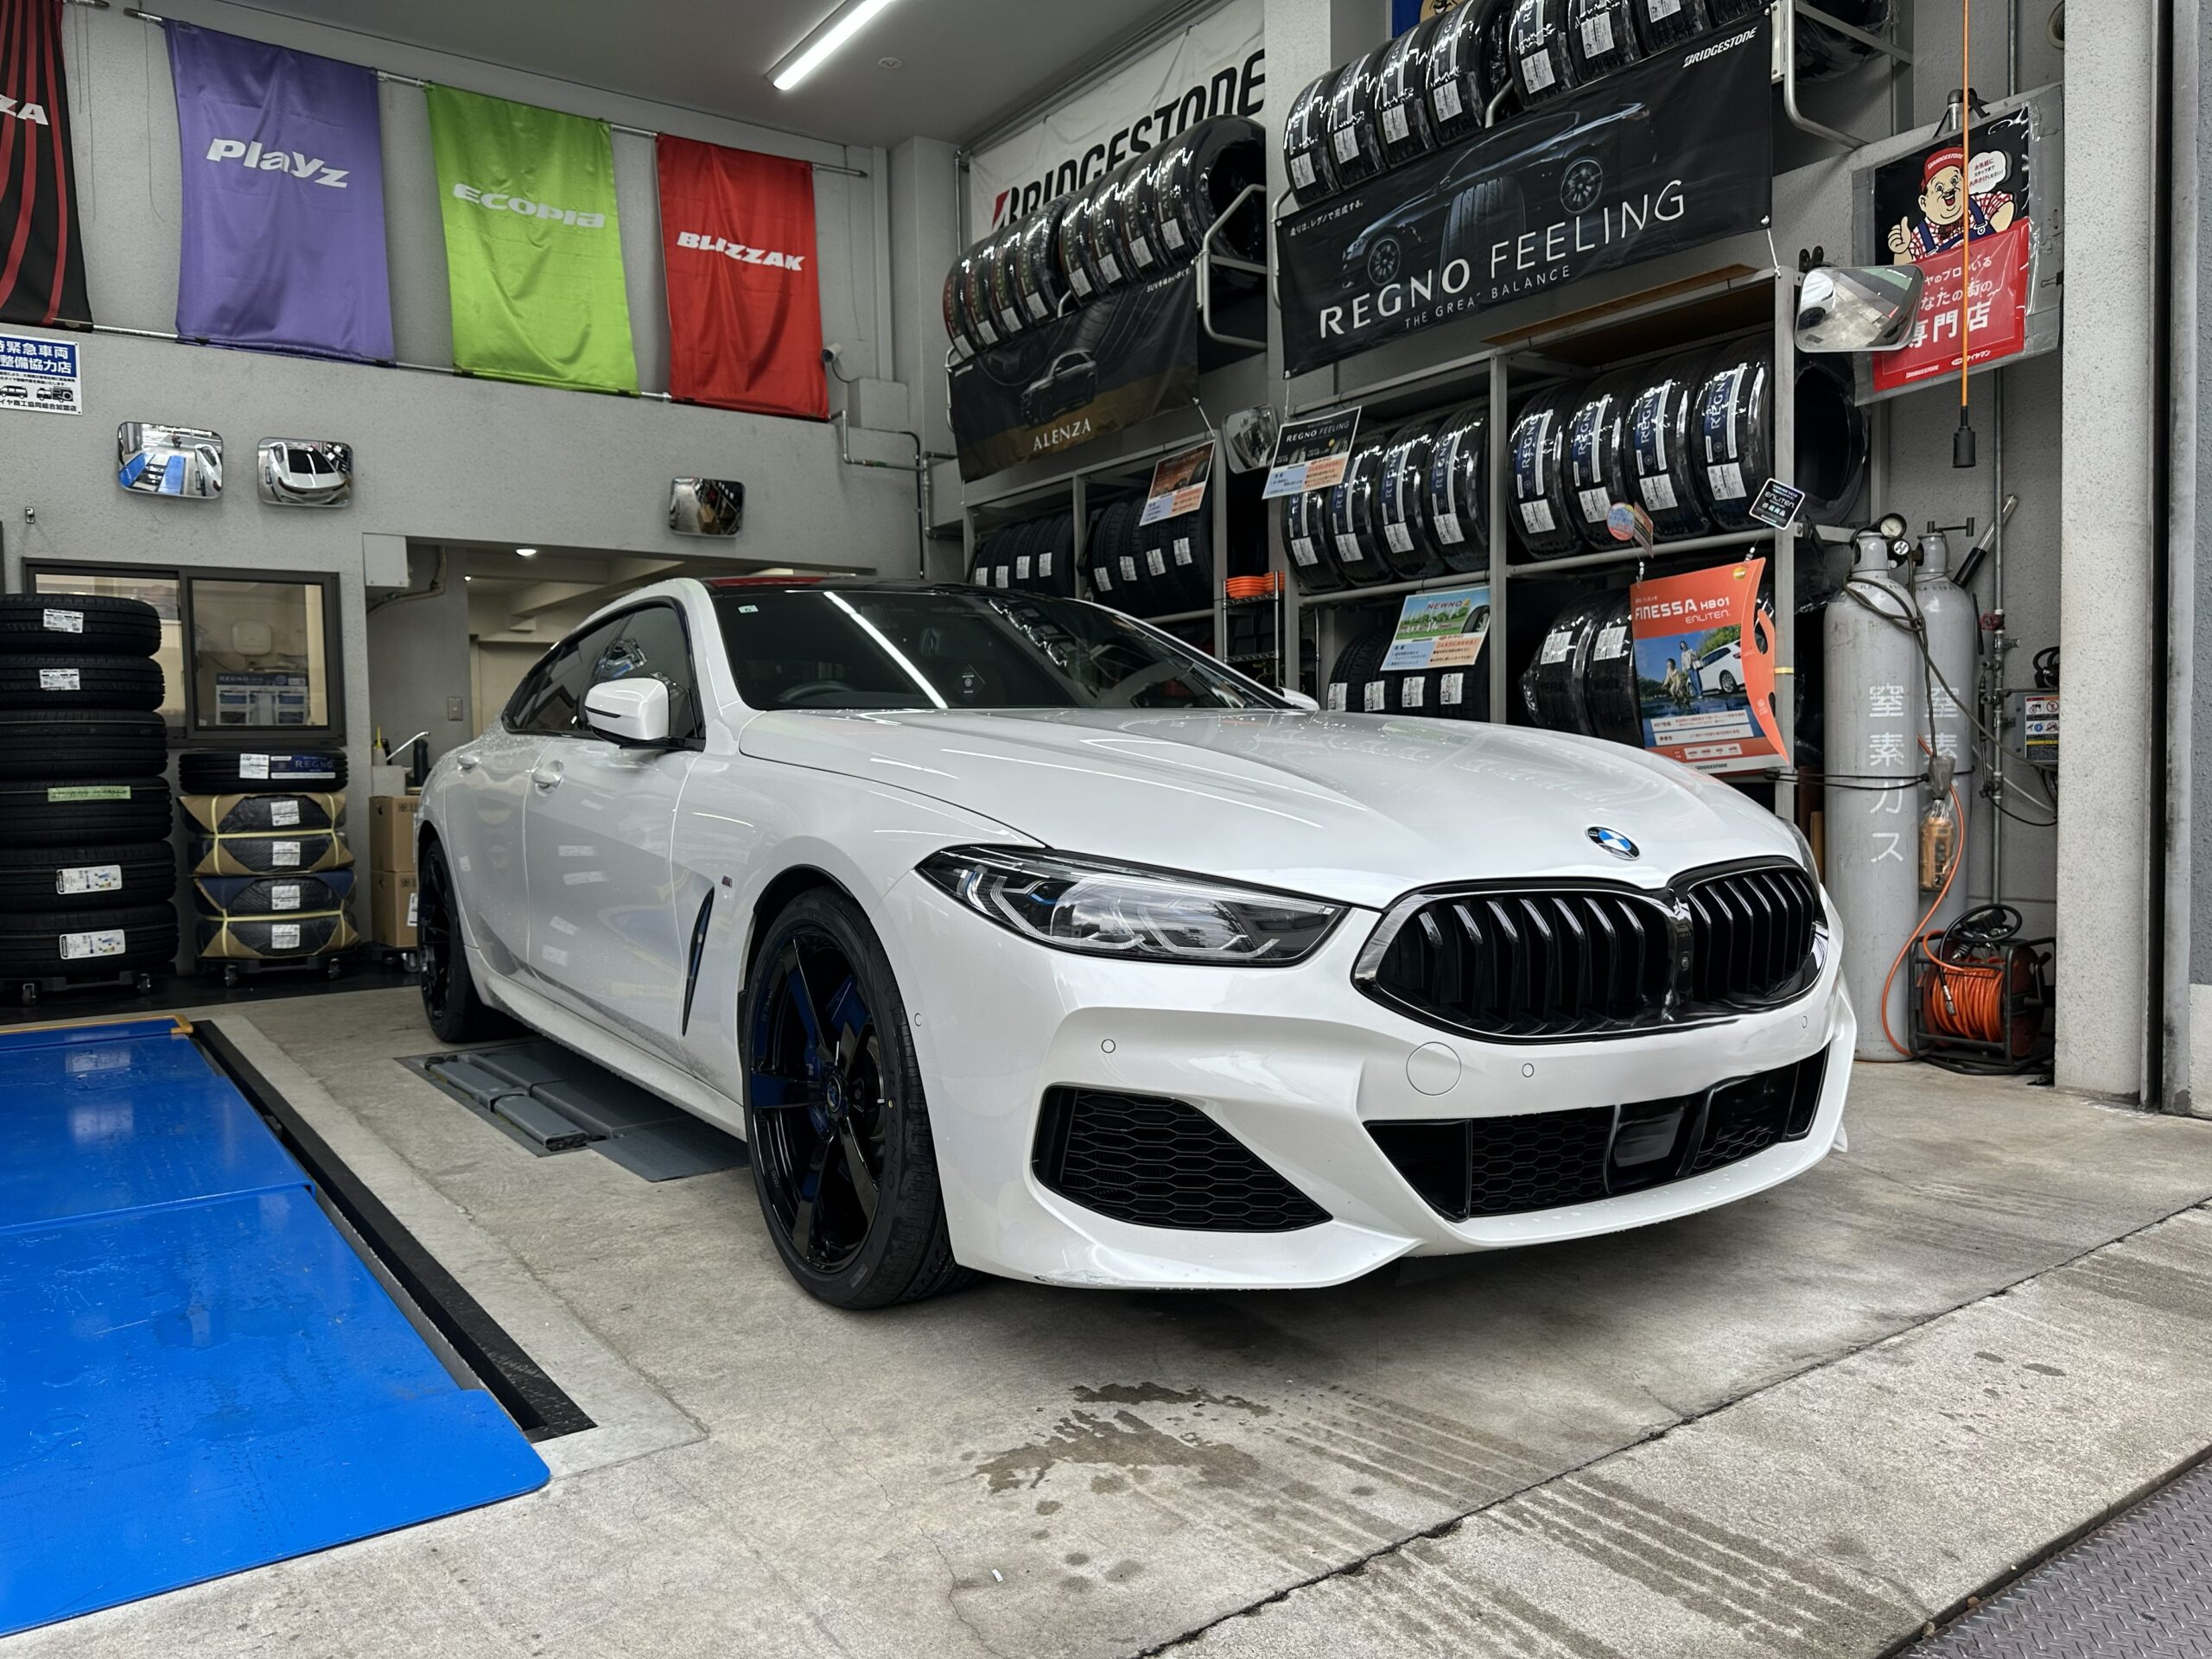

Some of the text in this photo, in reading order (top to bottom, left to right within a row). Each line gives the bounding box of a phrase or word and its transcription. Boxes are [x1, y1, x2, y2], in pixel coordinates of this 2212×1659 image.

[1683, 27, 1758, 68] BRIDGESTONE
[207, 137, 349, 188] Playz
[677, 230, 806, 272] BLIZZAK
[1319, 179, 1686, 340] REGNO FEELING
[1923, 256, 1993, 287] ヤのプロいる
[1404, 265, 1571, 329] THE GREA BALANCE
[0, 354, 73, 374] 整備協力店
[1033, 418, 1092, 452] ALENZA
[1286, 430, 1318, 443] REGNO
[1319, 421, 1351, 435] FEELING
[1427, 601, 1463, 610] NEWNO
[1635, 598, 1698, 621] FINESSA
[1700, 596, 1730, 611] HB01
[1686, 609, 1729, 624] ENLITEN
[1869, 683, 1905, 863] 窒素ガス
